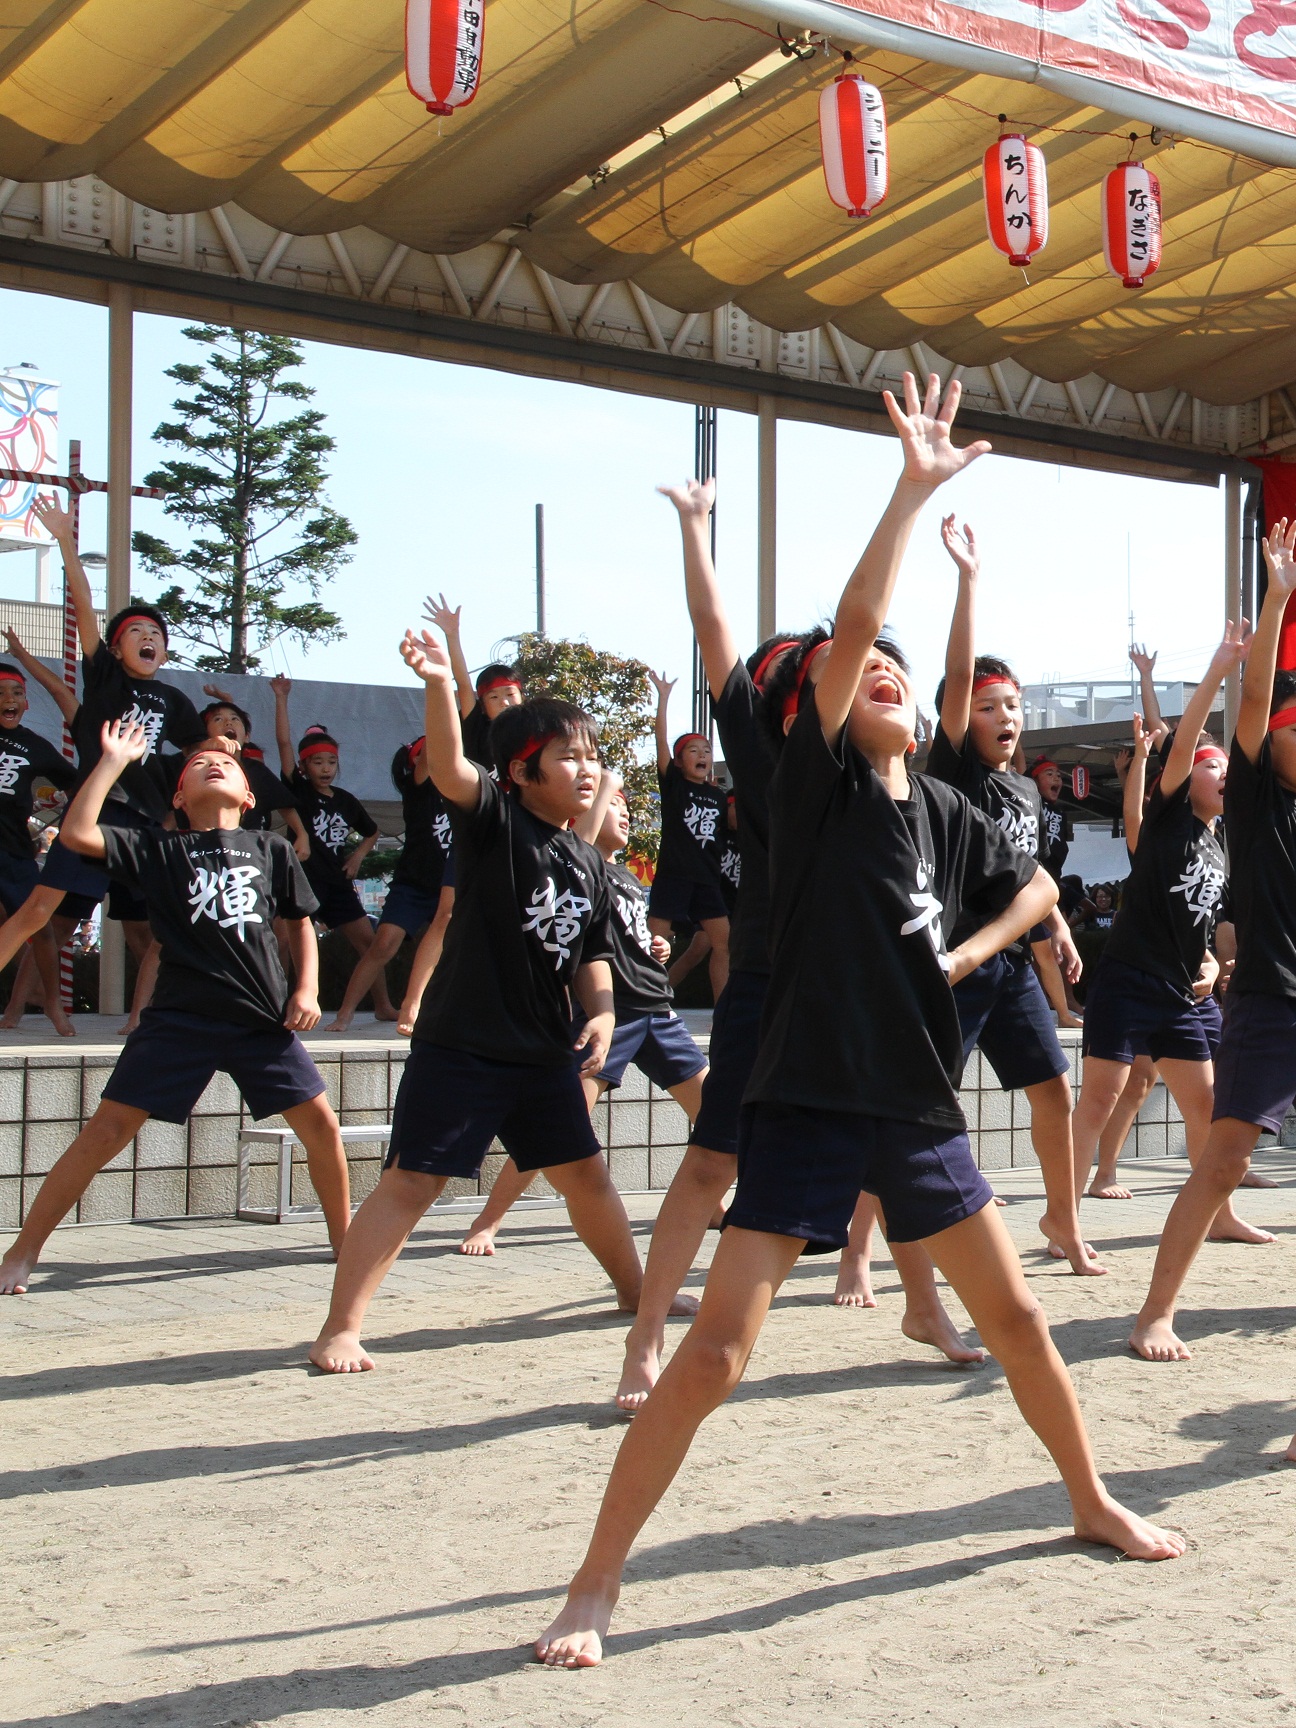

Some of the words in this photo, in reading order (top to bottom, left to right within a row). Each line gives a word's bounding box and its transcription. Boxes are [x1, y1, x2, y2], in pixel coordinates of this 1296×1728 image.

[454, 0, 480, 94] 田自動車
[1004, 153, 1033, 230] ちんか
[1128, 188, 1150, 260] なぎさ
[312, 808, 350, 856] 輝
[682, 801, 720, 850] 輝
[188, 865, 263, 943] 輝
[521, 876, 592, 972] 輝
[1168, 853, 1226, 928] 輝
